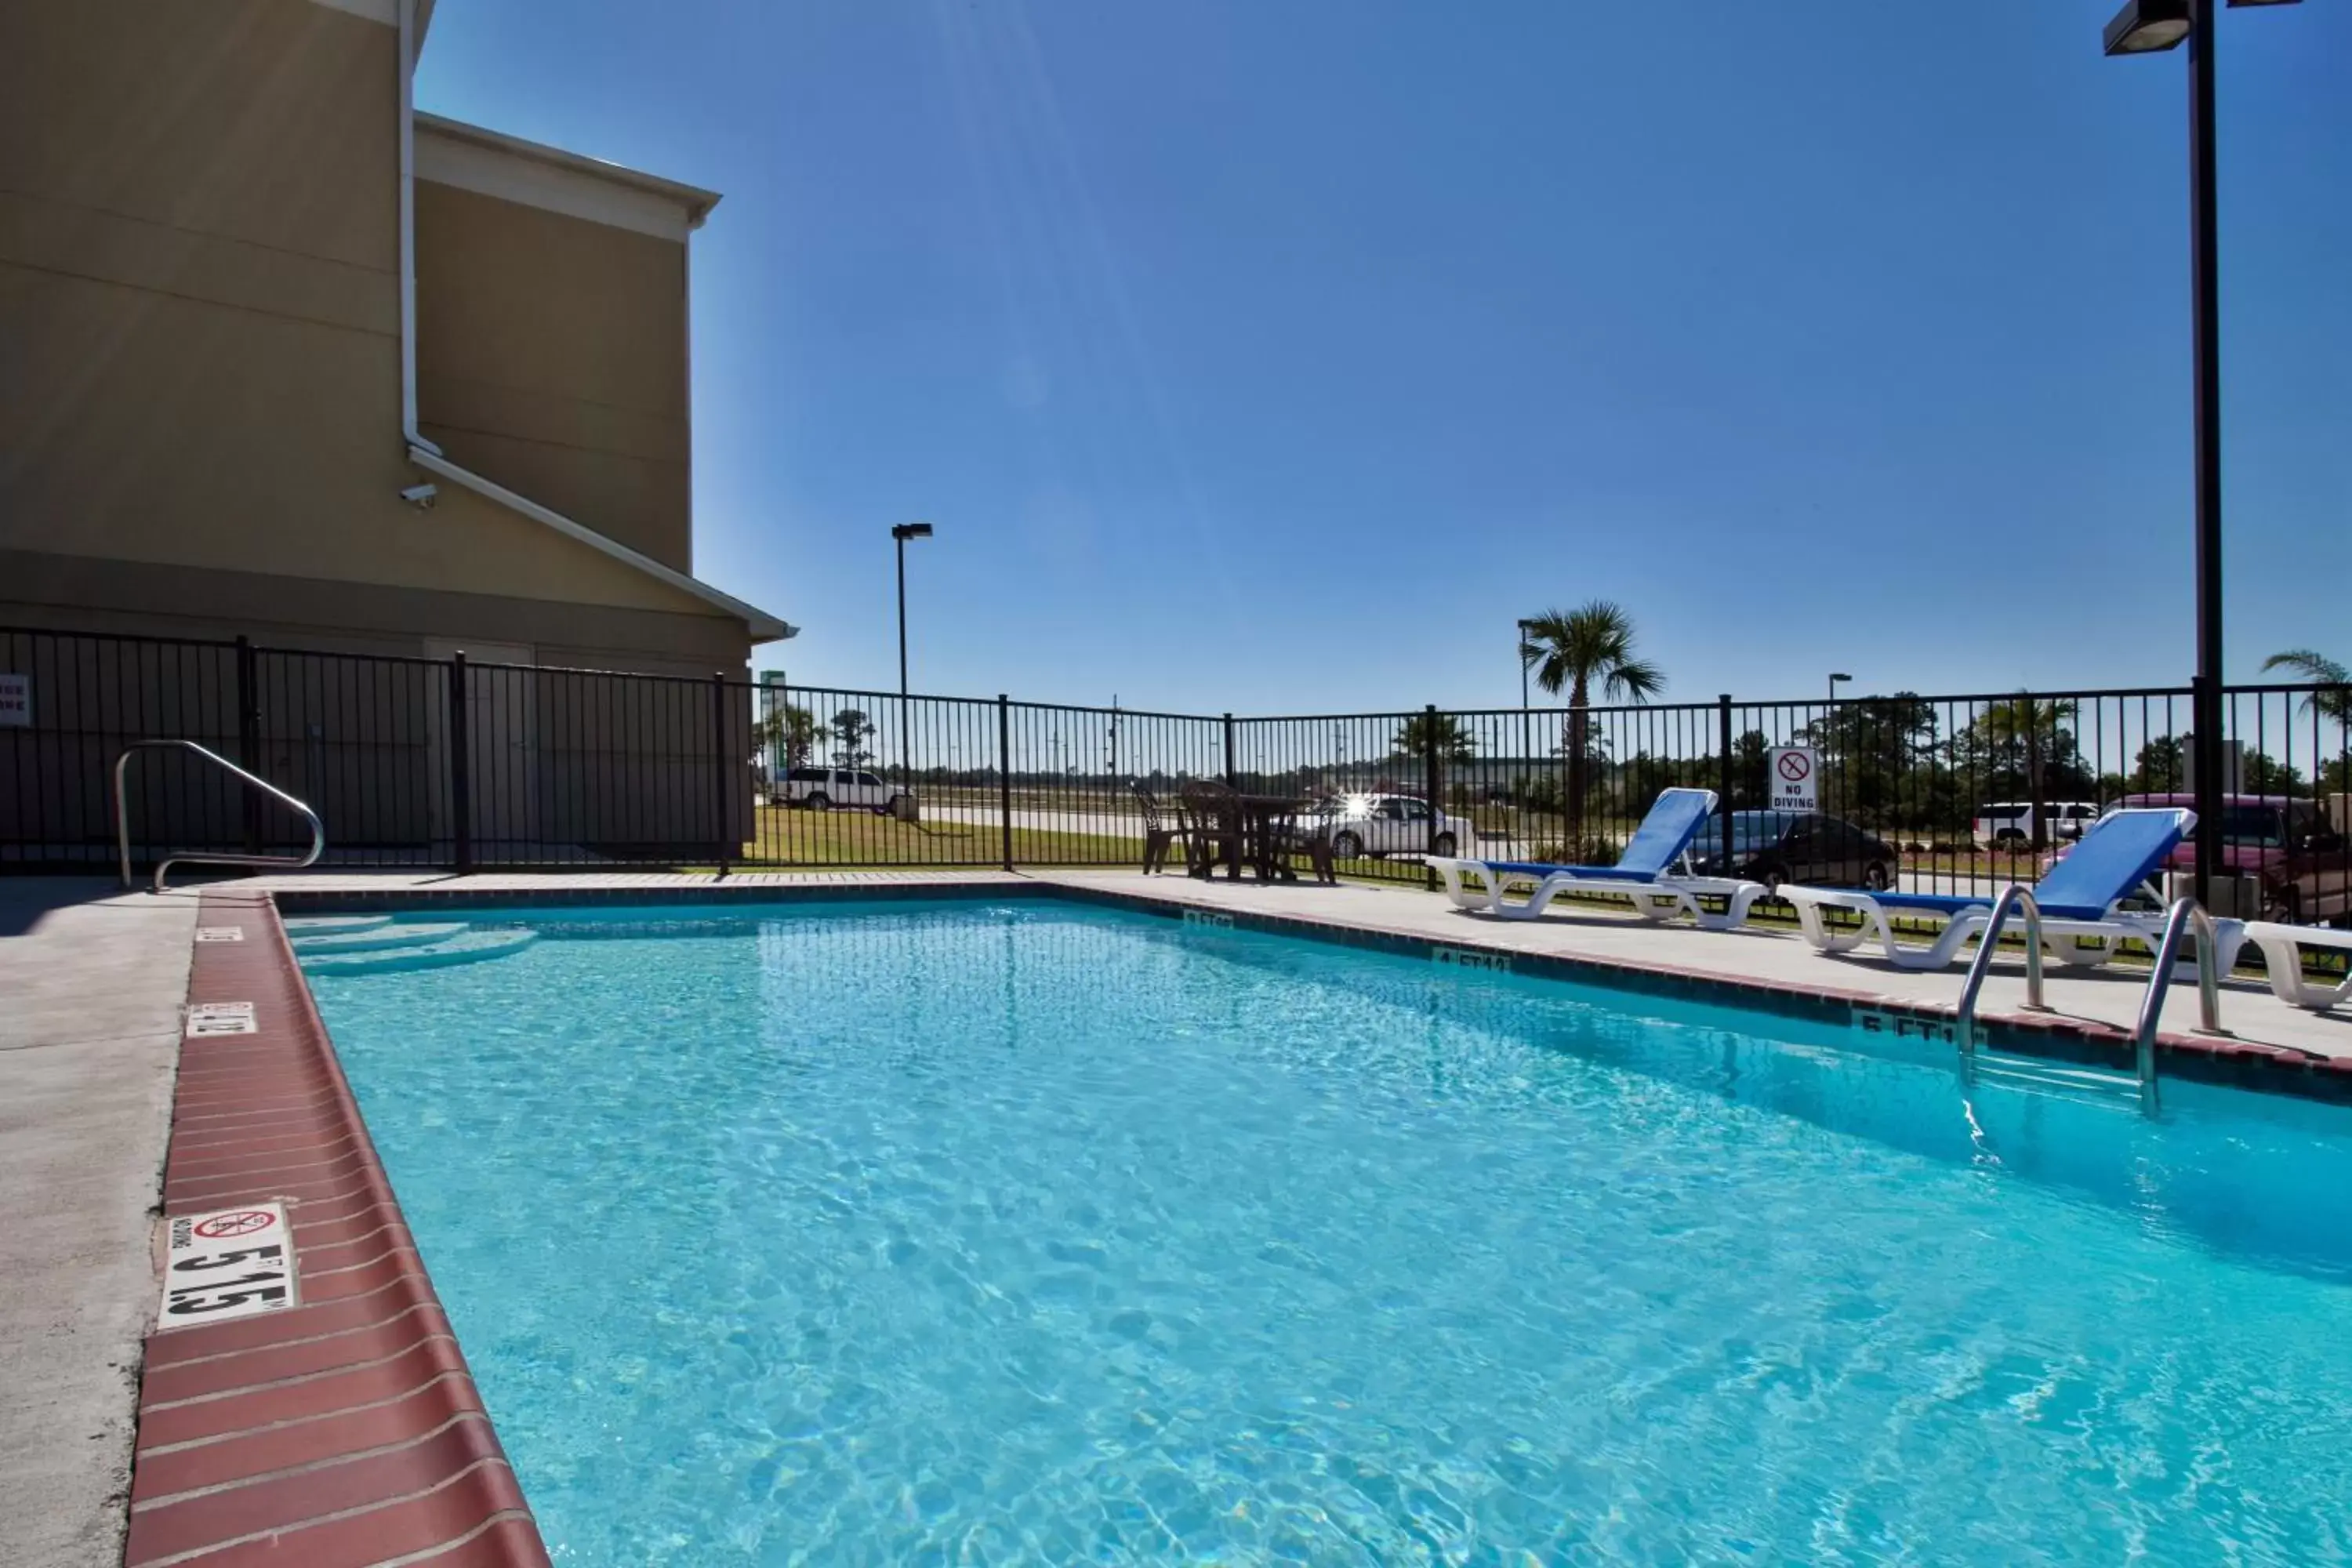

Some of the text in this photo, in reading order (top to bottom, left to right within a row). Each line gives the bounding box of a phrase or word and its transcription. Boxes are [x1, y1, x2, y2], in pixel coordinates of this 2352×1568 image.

[1785, 785, 1802, 795] NO
[1774, 797, 1813, 808] DIVING
[1896, 1018, 1937, 1041] FT
